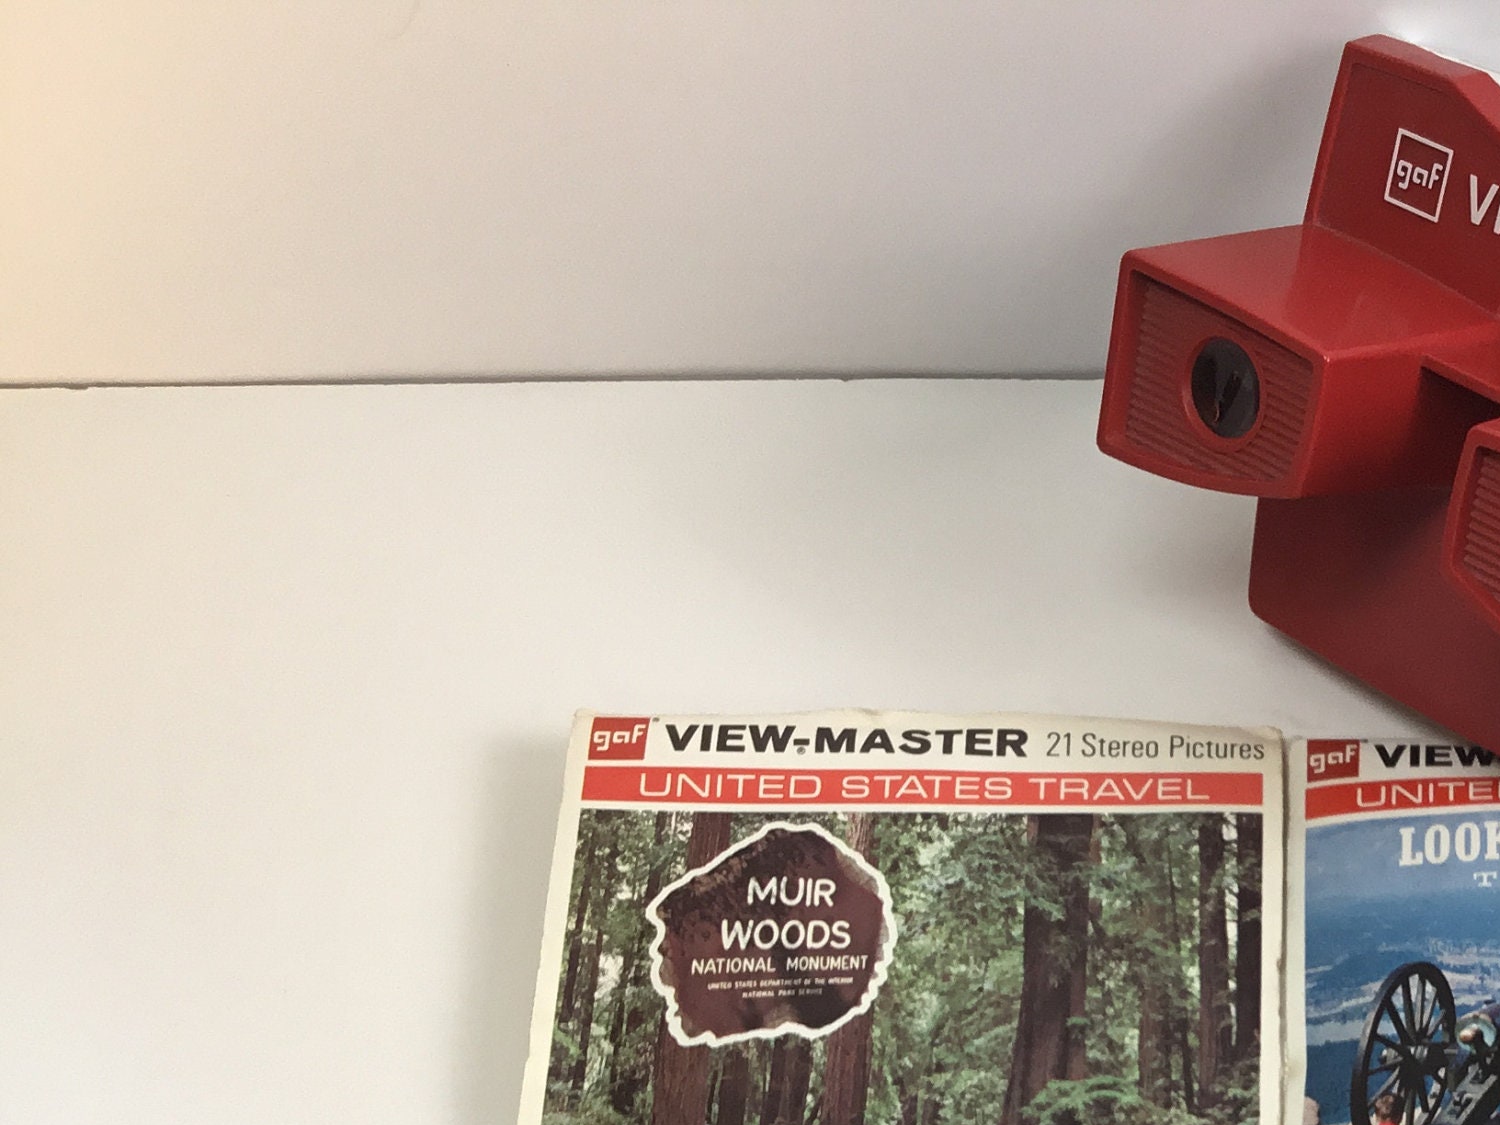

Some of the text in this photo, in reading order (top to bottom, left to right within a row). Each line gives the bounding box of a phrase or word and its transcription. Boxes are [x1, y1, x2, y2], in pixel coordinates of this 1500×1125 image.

[1396, 159, 1443, 190] gaf
[593, 723, 646, 751] gaf
[665, 724, 1265, 760] VIEW-MASTER 21 Stereo Pictures
[1308, 744, 1358, 773] gaf
[639, 772, 1210, 801] UNITED STATES TRAVEL
[747, 876, 837, 907] MUIR
[721, 918, 851, 950] WOODS
[691, 954, 869, 975] NATIONAL MONUMENT
